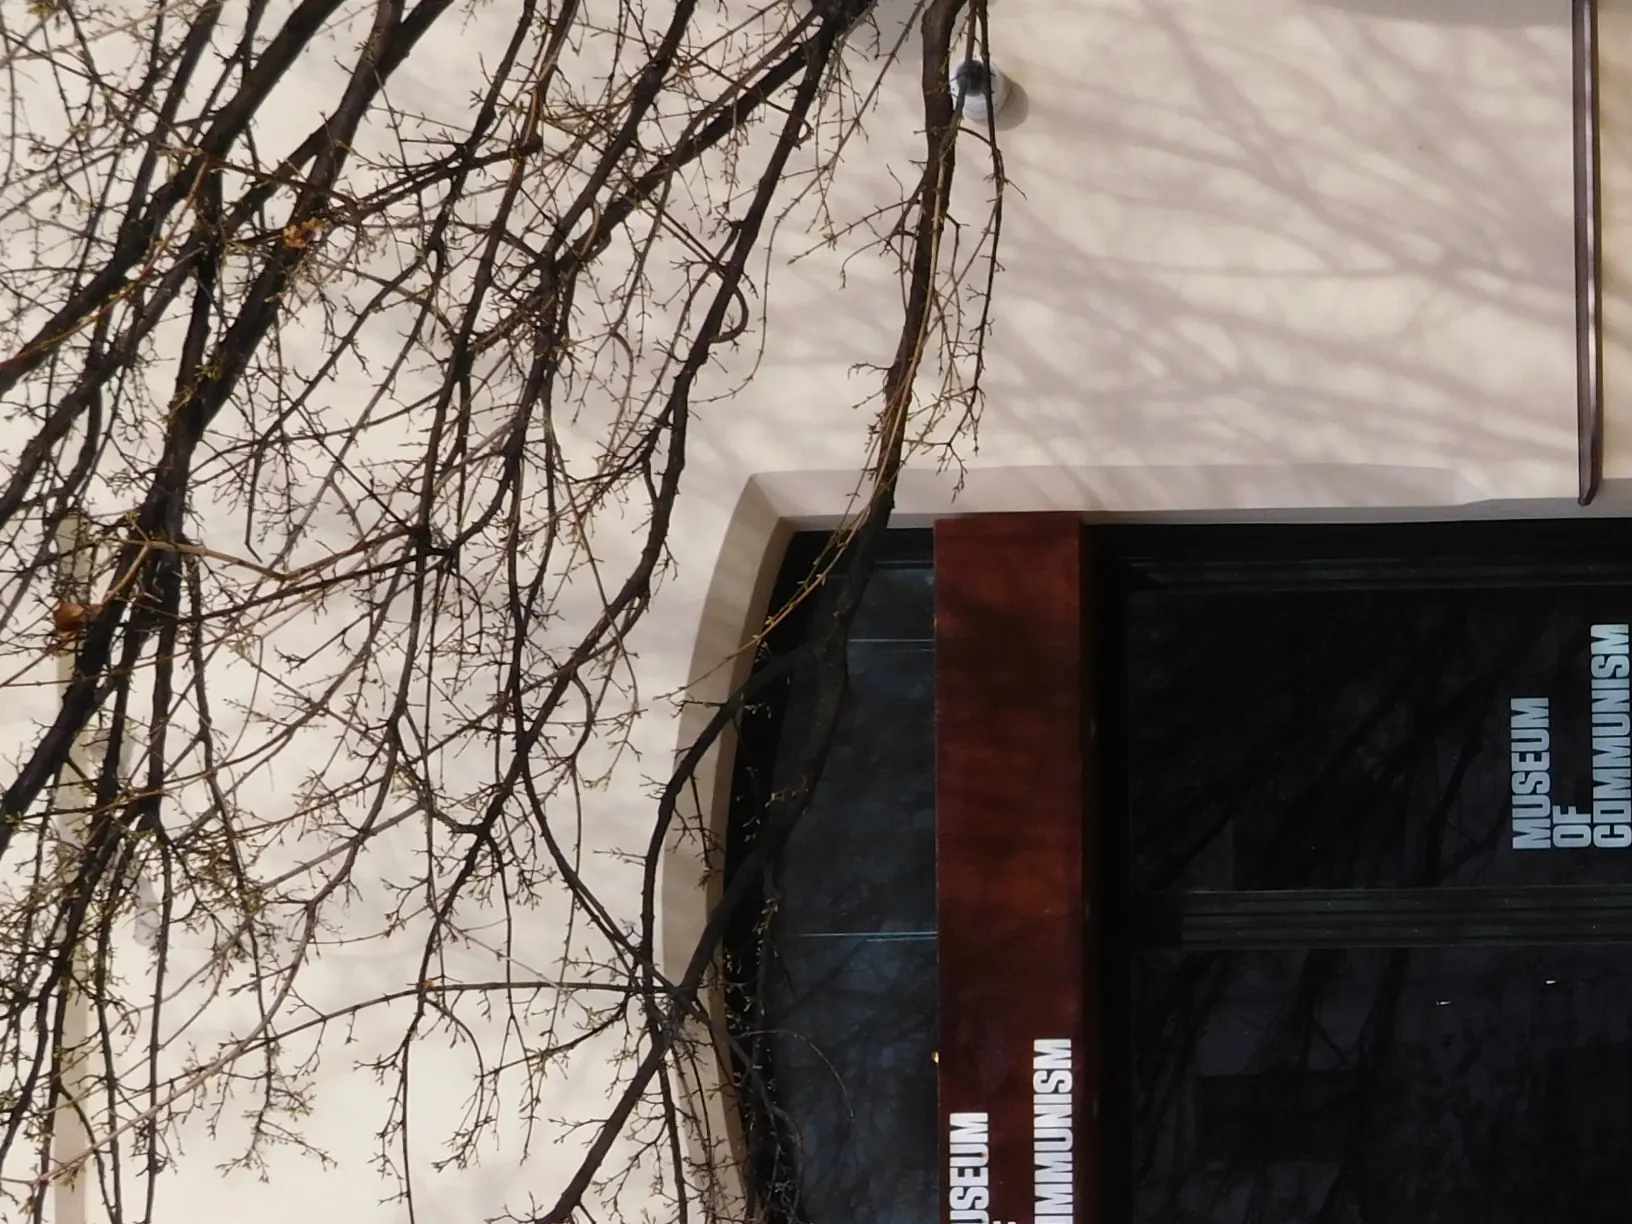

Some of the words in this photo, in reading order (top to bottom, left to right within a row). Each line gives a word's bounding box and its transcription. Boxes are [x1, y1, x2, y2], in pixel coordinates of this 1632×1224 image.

[1510, 697, 1551, 849] MUSEUM
[1590, 623, 1632, 848] COMMUNISM
[1552, 805, 1592, 848] OF
